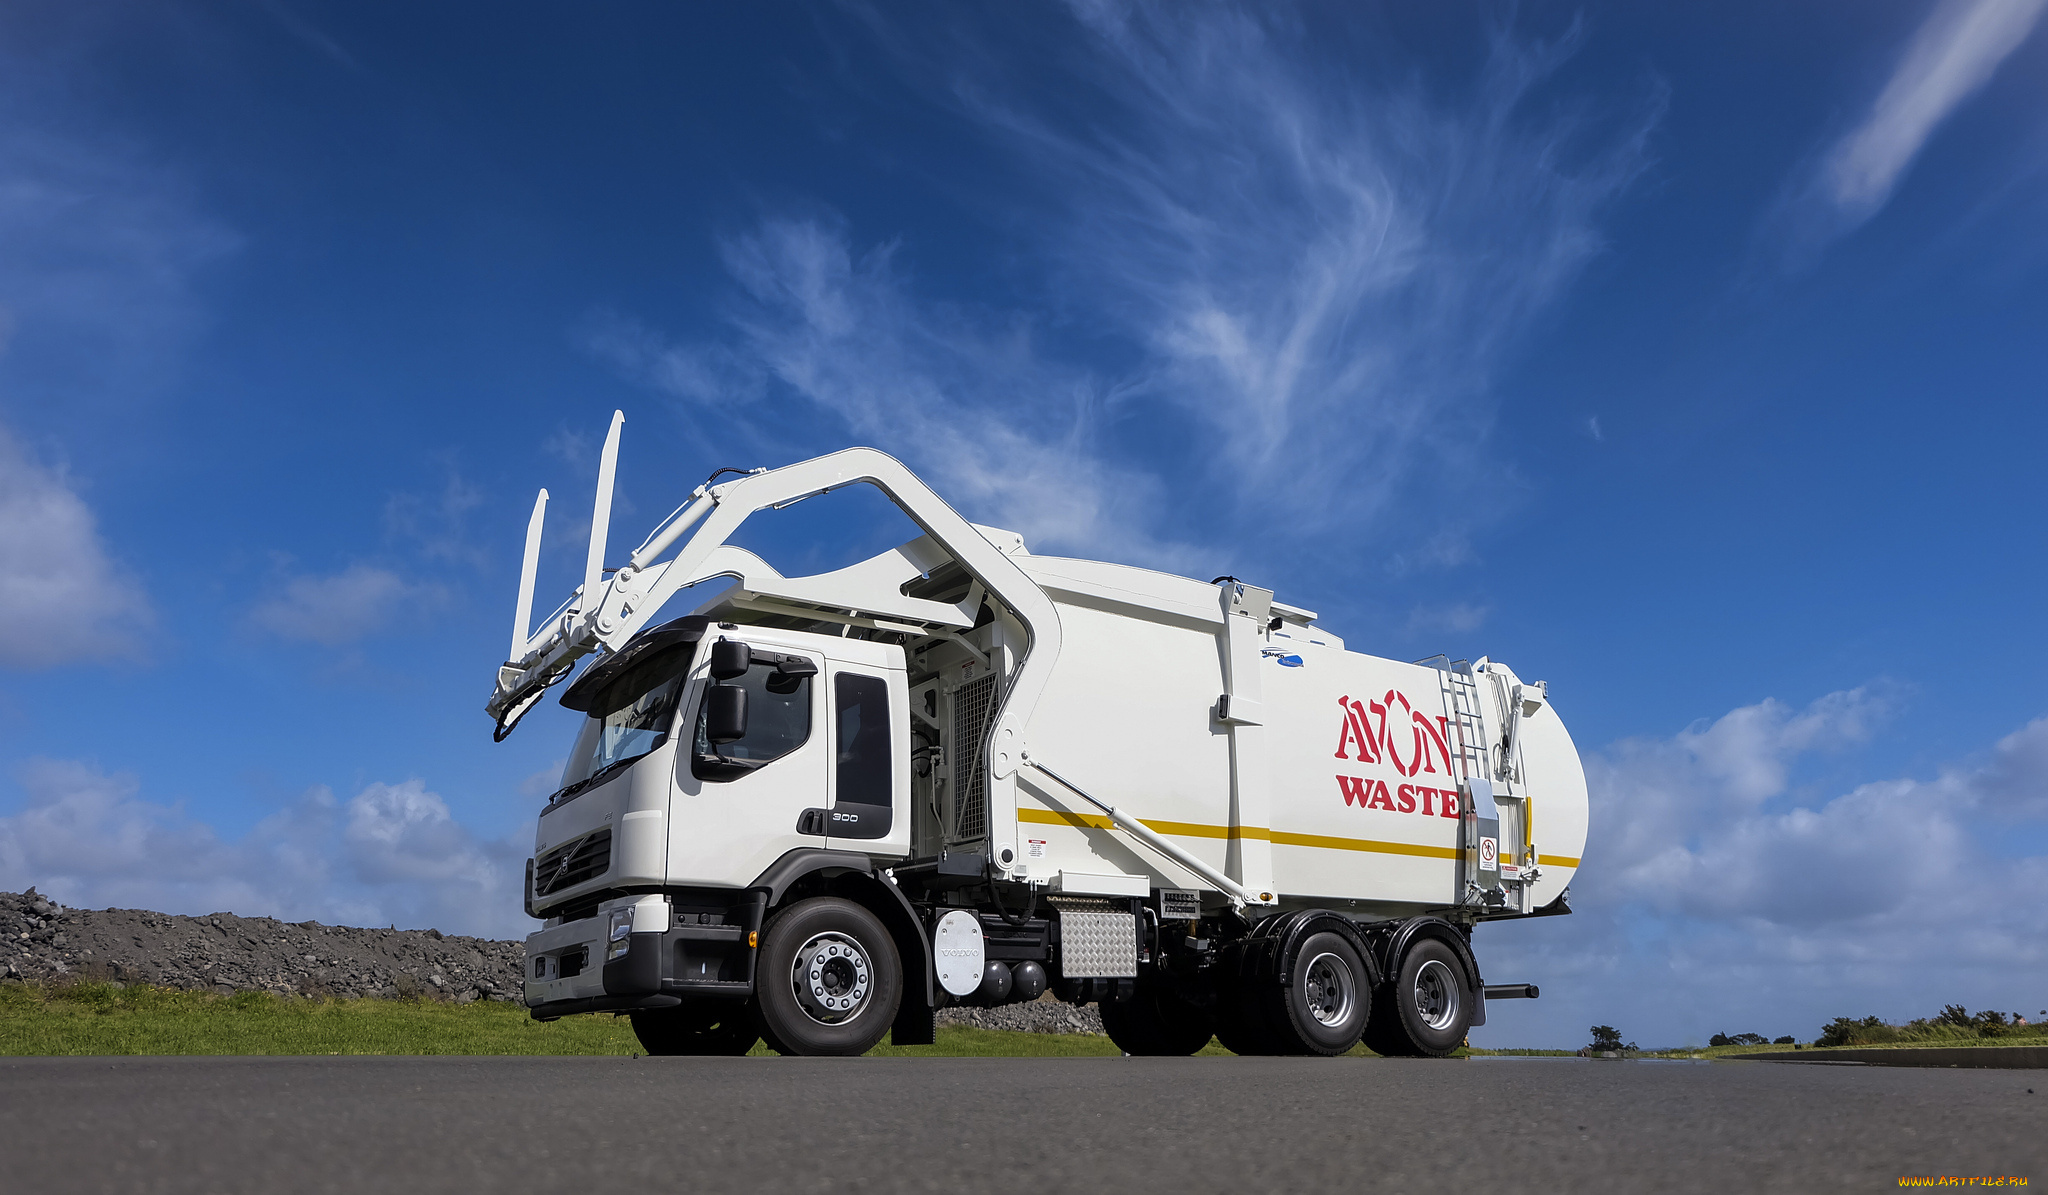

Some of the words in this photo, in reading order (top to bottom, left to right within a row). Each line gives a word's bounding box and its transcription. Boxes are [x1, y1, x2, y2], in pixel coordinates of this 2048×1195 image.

[1334, 689, 1452, 778] AVON
[1335, 774, 1461, 820] WASTE
[832, 812, 859, 823] 300
[941, 948, 980, 957] VOLVO
